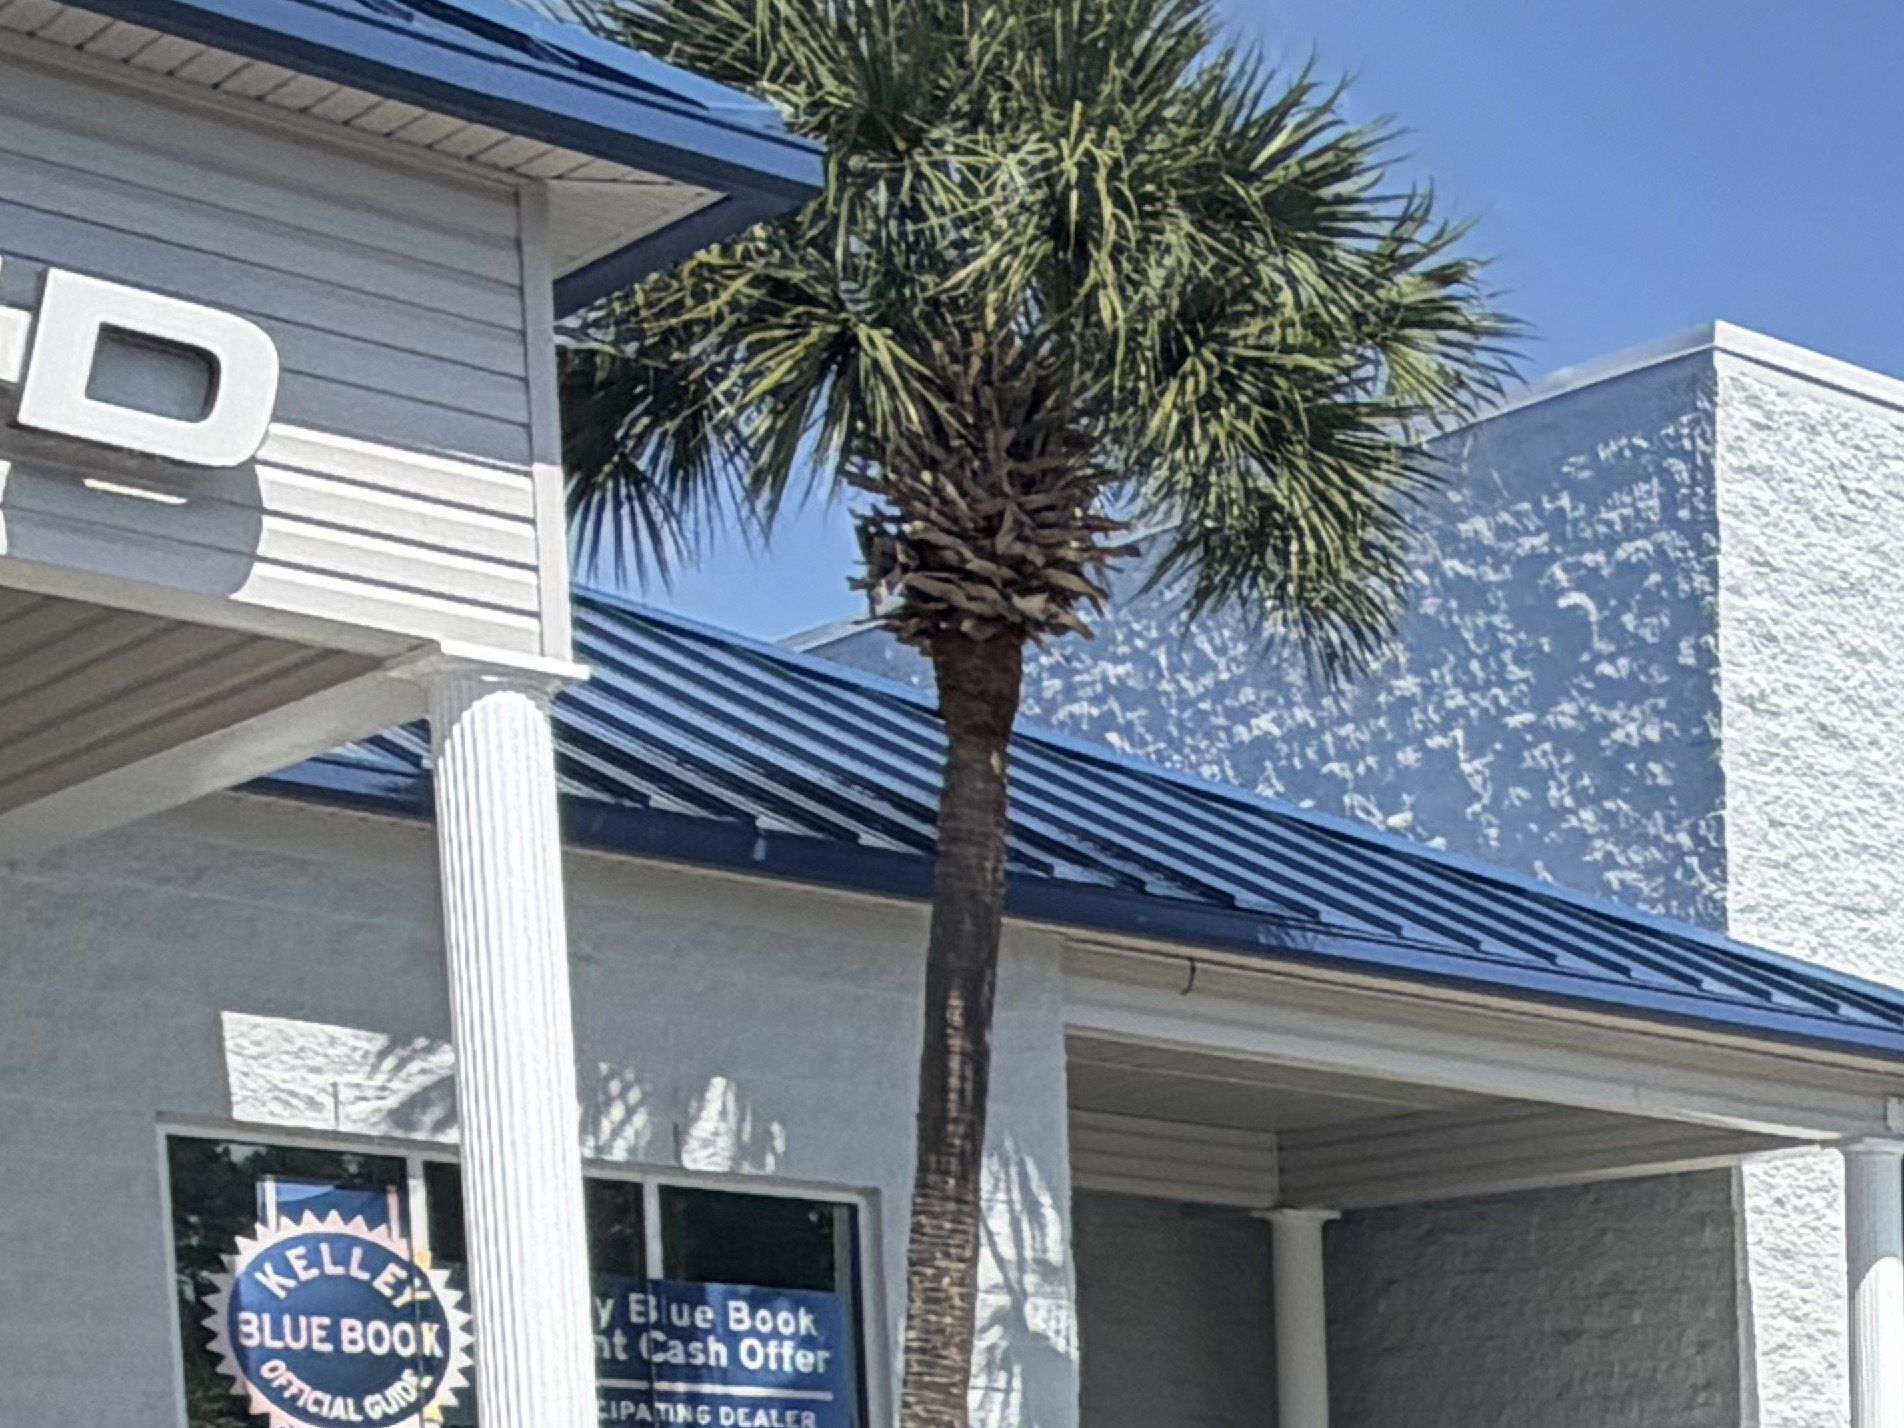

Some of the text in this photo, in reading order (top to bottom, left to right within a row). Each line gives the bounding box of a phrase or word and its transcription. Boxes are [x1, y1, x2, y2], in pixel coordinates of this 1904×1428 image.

[0, 254, 280, 467] D
[254, 1242, 432, 1309] KELLEY
[237, 1311, 444, 1358] BLUE BOOK
[728, 1300, 818, 1336] Book
[638, 1330, 728, 1367] Cash
[739, 1338, 831, 1373] Offer
[260, 1359, 364, 1422] OFFICIAL
